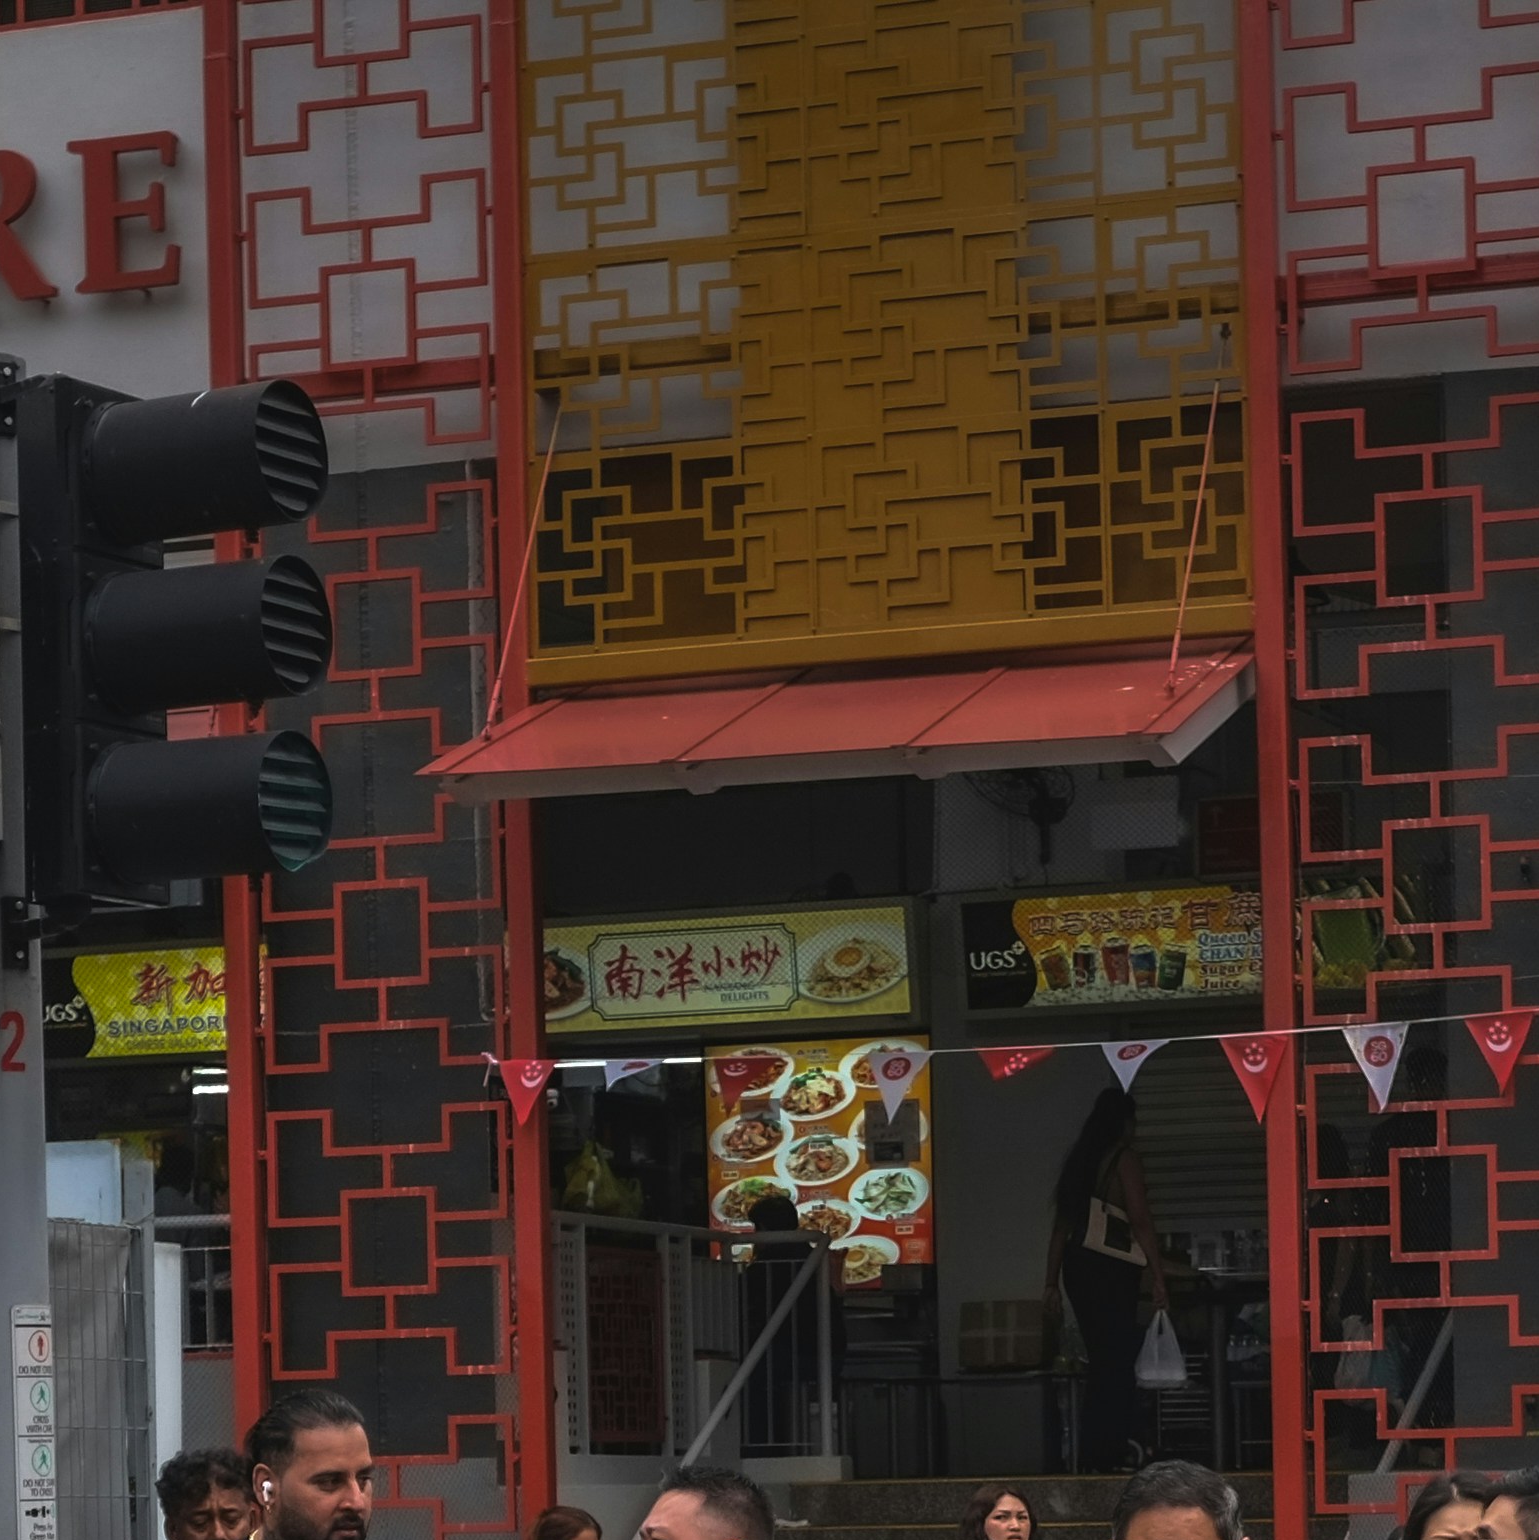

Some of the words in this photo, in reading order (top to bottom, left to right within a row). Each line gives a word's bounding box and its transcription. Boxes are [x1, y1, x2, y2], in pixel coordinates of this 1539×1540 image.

[1198, 932, 1247, 947] Queen
[1199, 947, 1244, 960] CHAN
[969, 951, 1015, 971] UGS
[604, 935, 781, 1002] 南洋小炒
[1200, 964, 1243, 976] Sugar
[1200, 978, 1240, 990] Juice
[721, 990, 770, 1003] DELIGHTS
[108, 1015, 226, 1037] SINGAPOR
